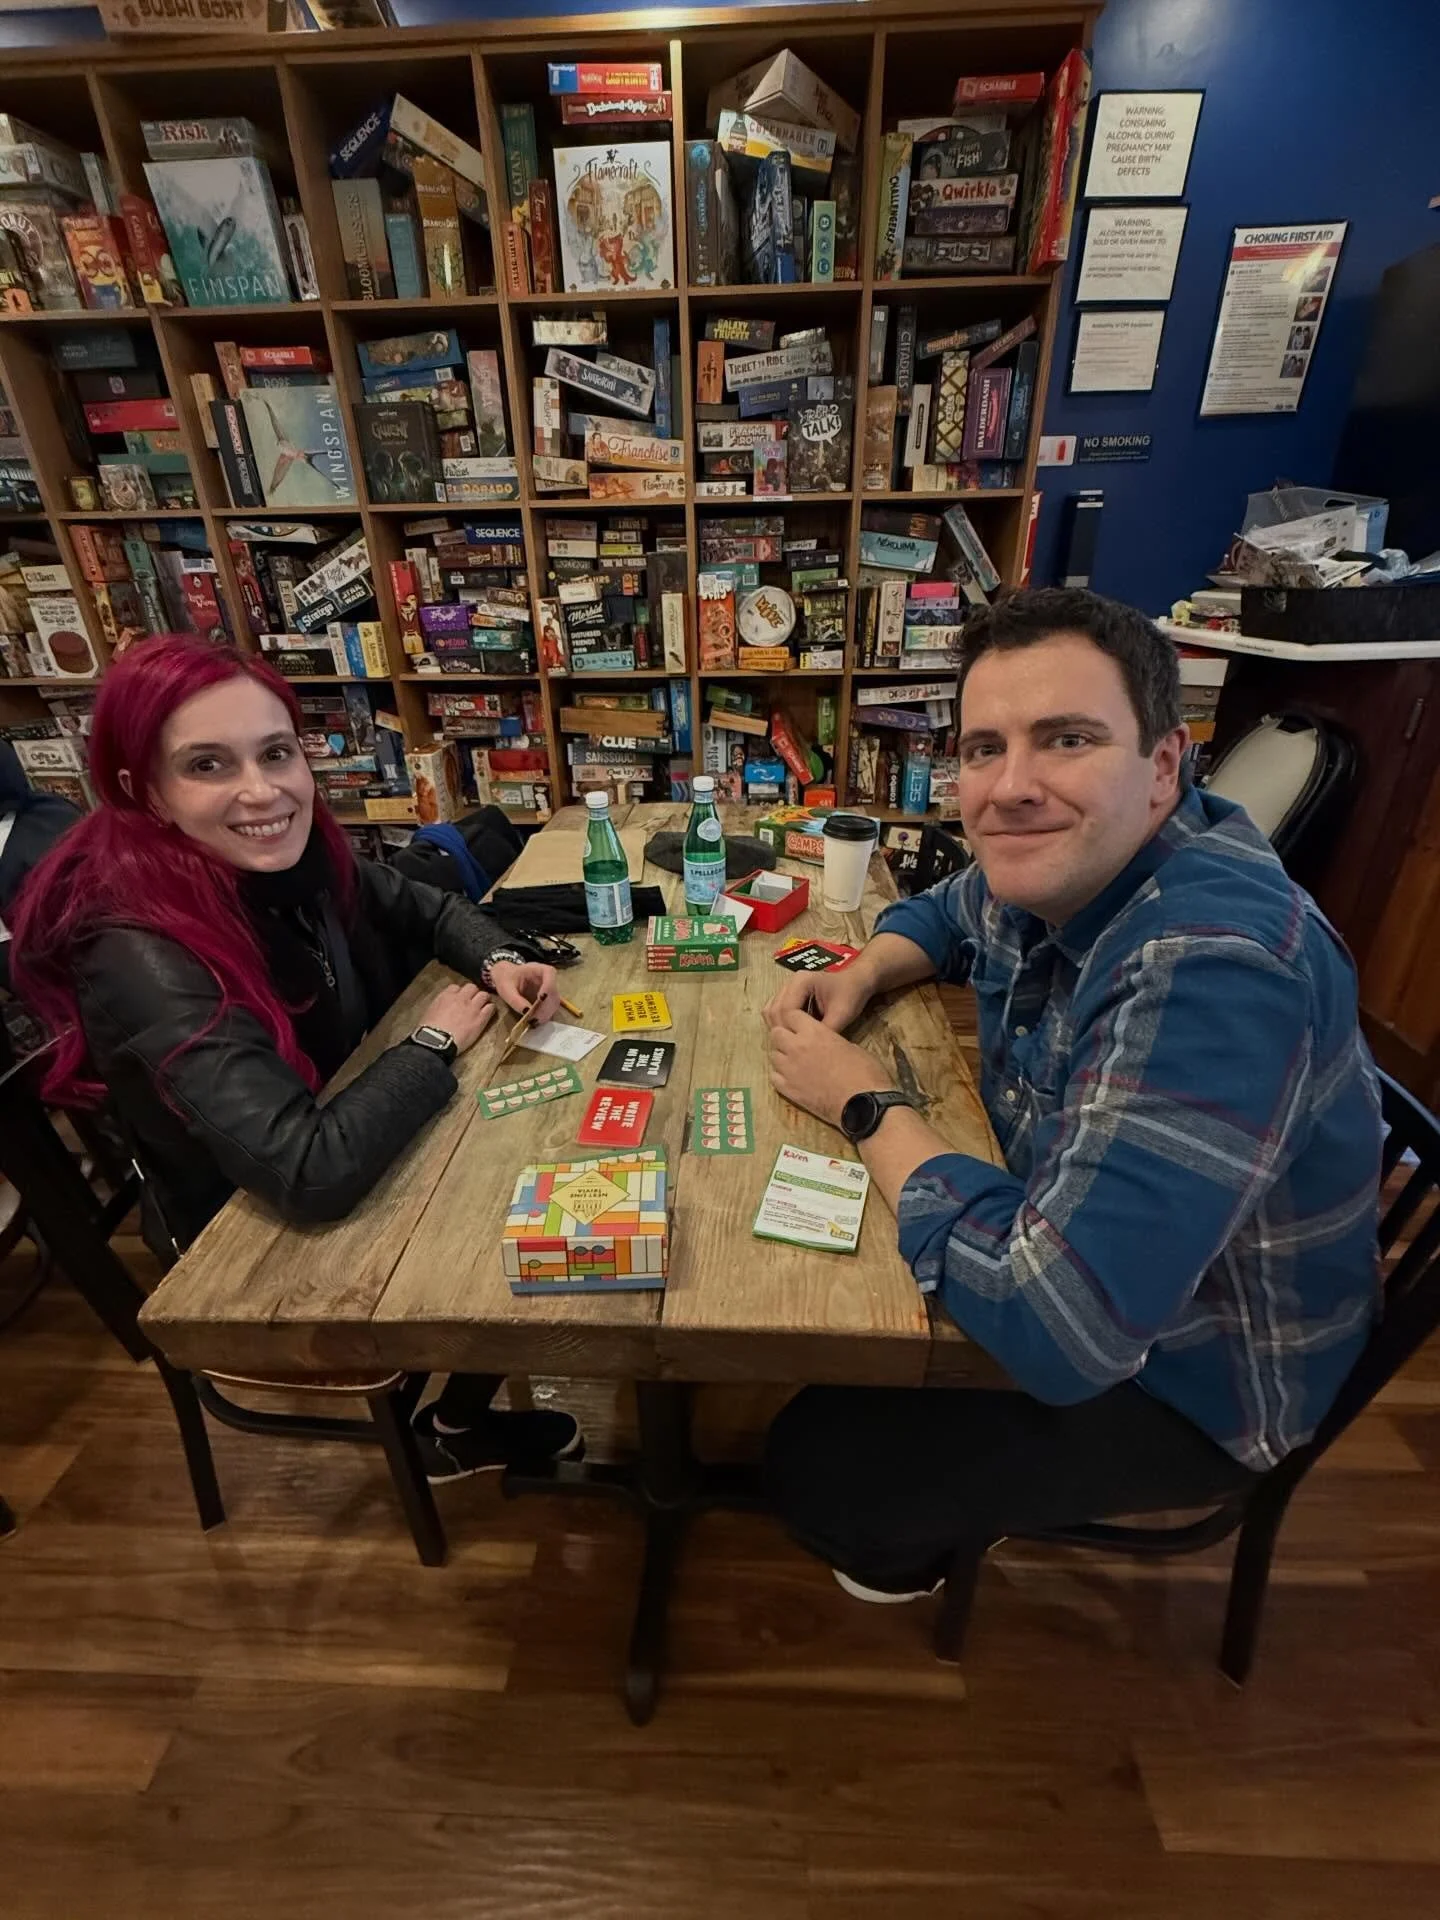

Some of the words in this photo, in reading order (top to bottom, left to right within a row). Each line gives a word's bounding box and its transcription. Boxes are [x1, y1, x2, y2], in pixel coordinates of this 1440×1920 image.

[750, 120, 816, 145] COPENHAGEN
[1120, 119, 1166, 128] CONSUMING
[160, 124, 210, 142] Risk
[339, 112, 382, 162] SEQUENCE
[1106, 131, 1142, 140] ALCOHOL
[1145, 131, 1175, 140] DURING
[1106, 143, 1153, 152] PREGNANCY
[1154, 143, 1172, 151] MAY
[956, 151, 983, 168] FISH!
[1112, 155, 1137, 164] CAUSE
[1138, 155, 1161, 163] BIRTH
[511, 150, 524, 196] CATAN
[585, 157, 638, 181] Flamecraft
[1117, 167, 1151, 176] DEFECTS
[942, 182, 998, 201] Qwirkle
[1244, 232, 1289, 244] CHOKING
[1290, 231, 1316, 242] FIRST
[1316, 230, 1334, 240] AID
[188, 275, 283, 299] FINSPAN
[717, 319, 749, 330] GALAXY
[728, 358, 757, 375] TICKET
[766, 355, 785, 366] RIDE
[899, 331, 911, 389] CITADELS
[977, 378, 990, 449] BALDERDASH
[803, 415, 841, 438] TALK!
[316, 393, 350, 500] WINGSPAN
[607, 436, 668, 462] Franchise
[1083, 438, 1100, 448] NO
[1101, 435, 1151, 447] SMOKING
[463, 483, 513, 494] DORADO
[475, 528, 520, 538] SEQUENCE
[342, 583, 363, 599] STAR
[345, 589, 367, 605] WARS
[302, 602, 334, 627] Stratego
[602, 735, 637, 750] CLUE
[889, 774, 898, 796] combo
[909, 767, 924, 803] SETI
[787, 948, 818, 964] BLANKS
[802, 955, 817, 965] THE
[817, 956, 832, 965] FILL
[622, 999, 635, 1022] WHAT'S
[634, 1001, 648, 1019] BEING
[644, 994, 660, 1023] REVIEWED
[621, 1057, 635, 1072] FILL
[628, 1048, 639, 1058] IN
[636, 1053, 650, 1068] THE
[647, 1047, 665, 1076] BLANKS
[591, 1096, 613, 1131] REVIEW
[609, 1105, 625, 1121] THE
[621, 1100, 641, 1129] WRITE
